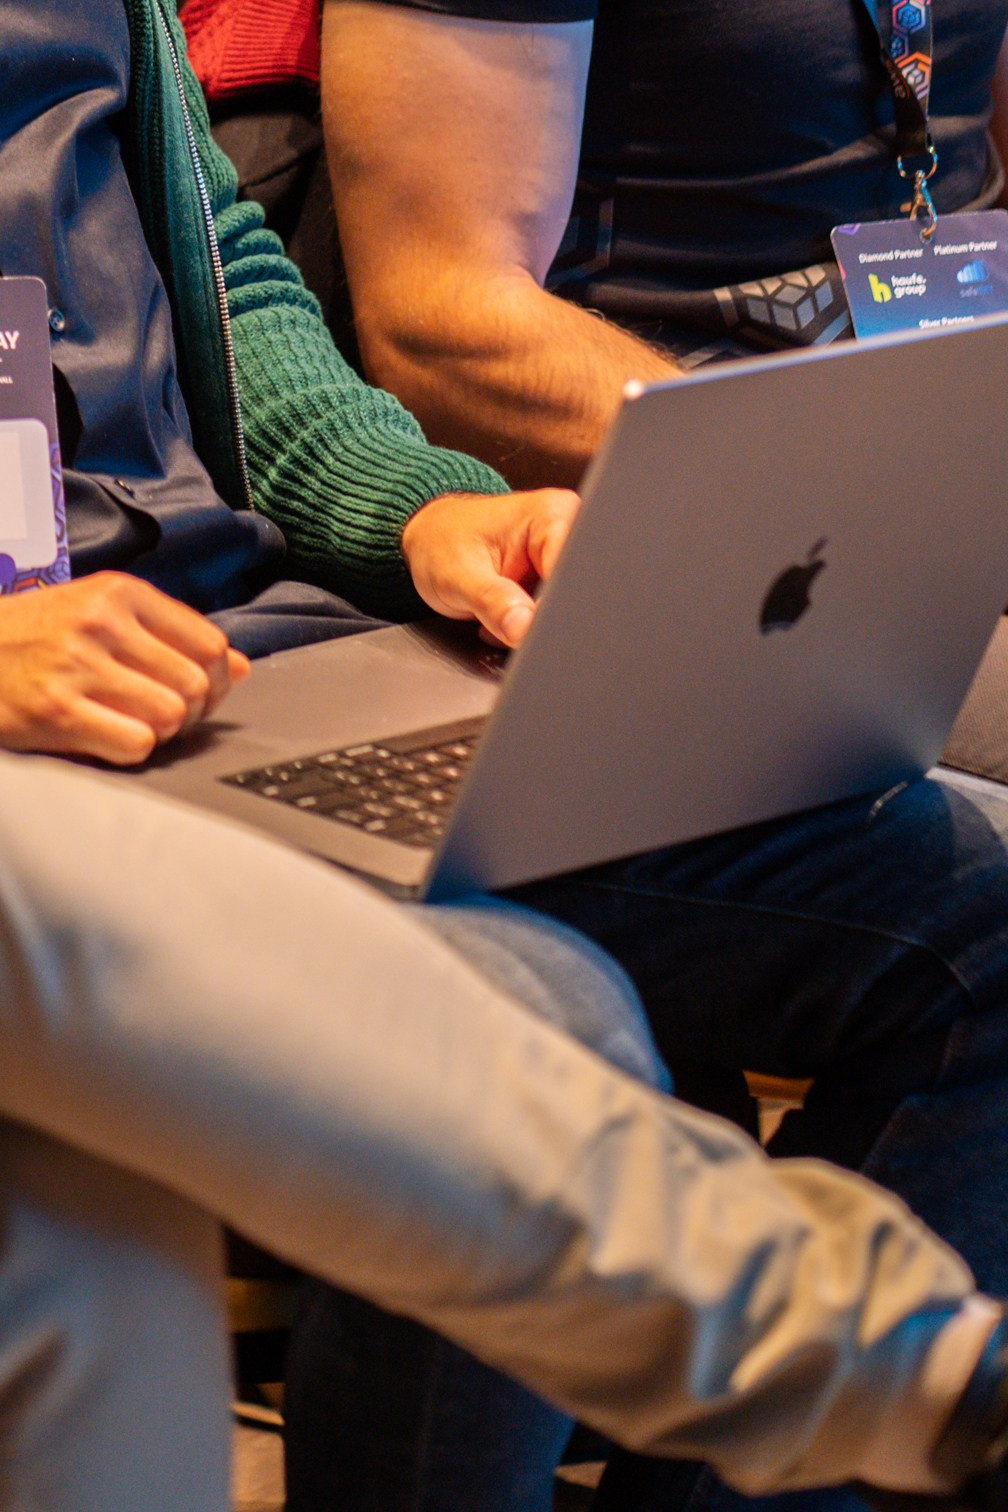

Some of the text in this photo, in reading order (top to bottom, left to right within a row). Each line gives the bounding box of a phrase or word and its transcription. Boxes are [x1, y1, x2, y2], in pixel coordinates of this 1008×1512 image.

[858, 248, 924, 264] Diamond Partner
[934, 240, 998, 256] Platinum Partner
